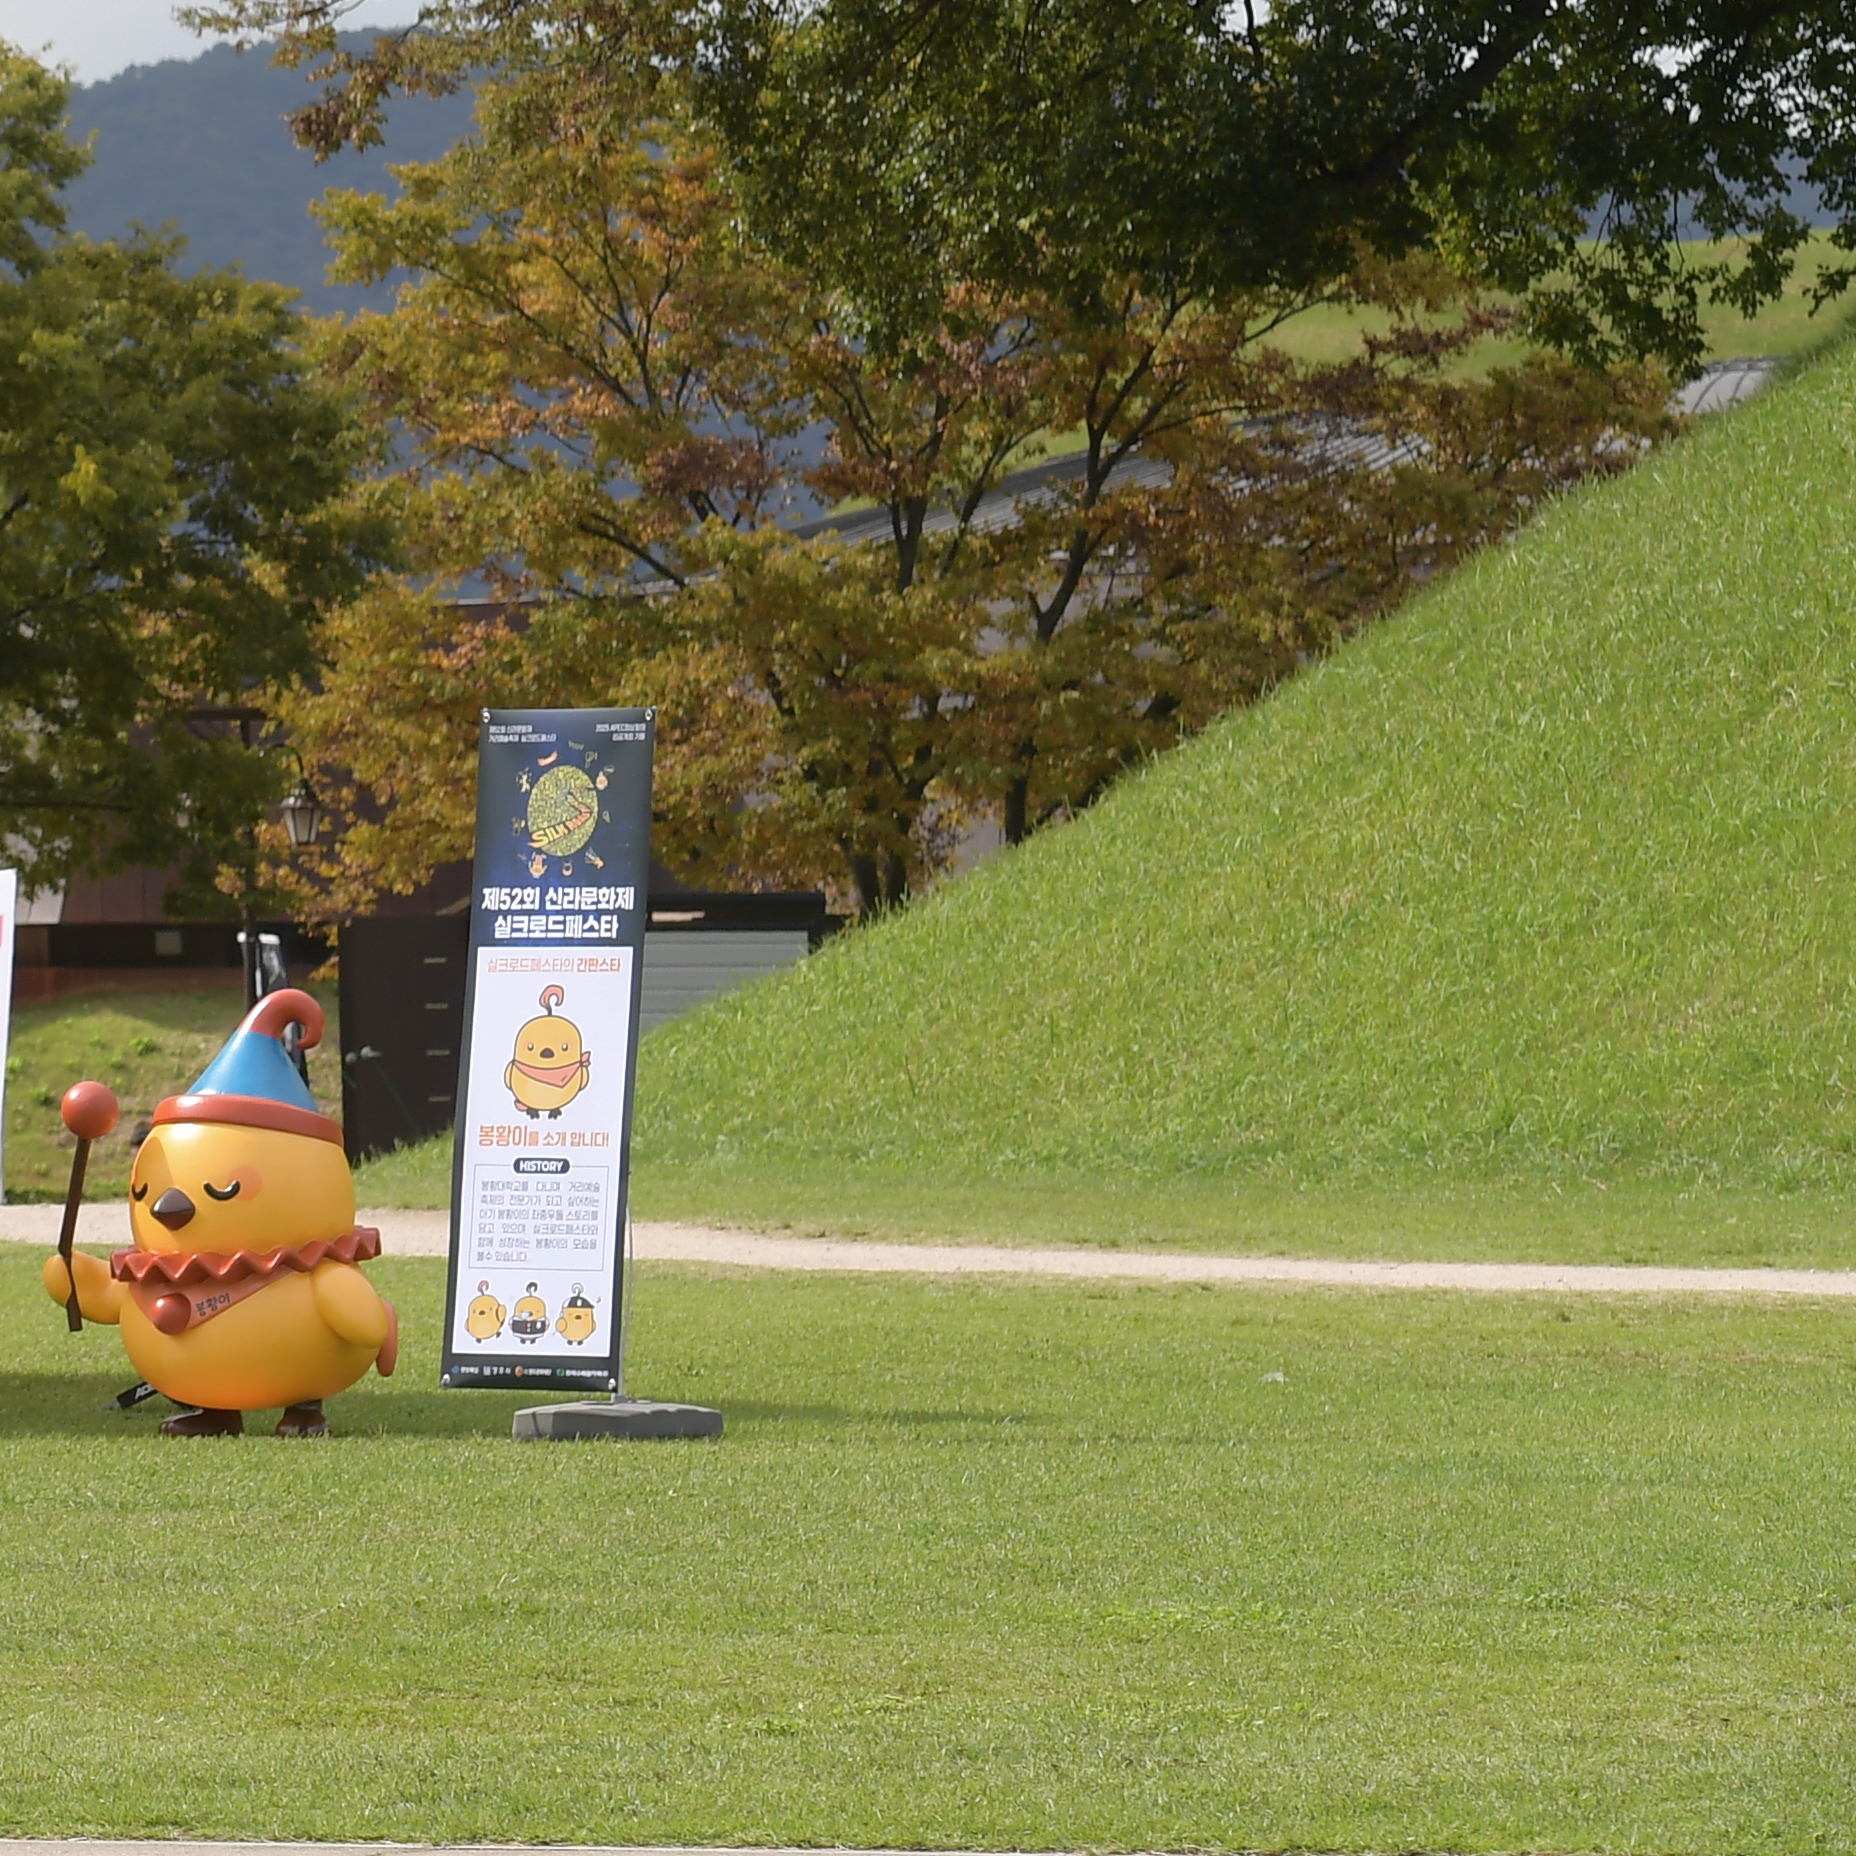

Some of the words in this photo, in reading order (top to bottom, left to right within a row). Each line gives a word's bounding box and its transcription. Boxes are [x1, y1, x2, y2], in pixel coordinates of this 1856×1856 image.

[481, 886, 540, 910] 제52회
[545, 886, 635, 910] 신라문화제
[494, 914, 619, 939] 실크로드페스타
[488, 958, 574, 973] 실크로드페스타의
[577, 958, 621, 973] 간판스타
[543, 1132, 566, 1147] 소개
[519, 1160, 564, 1172] HISTORY
[196, 1292, 230, 1316] 봉황이
